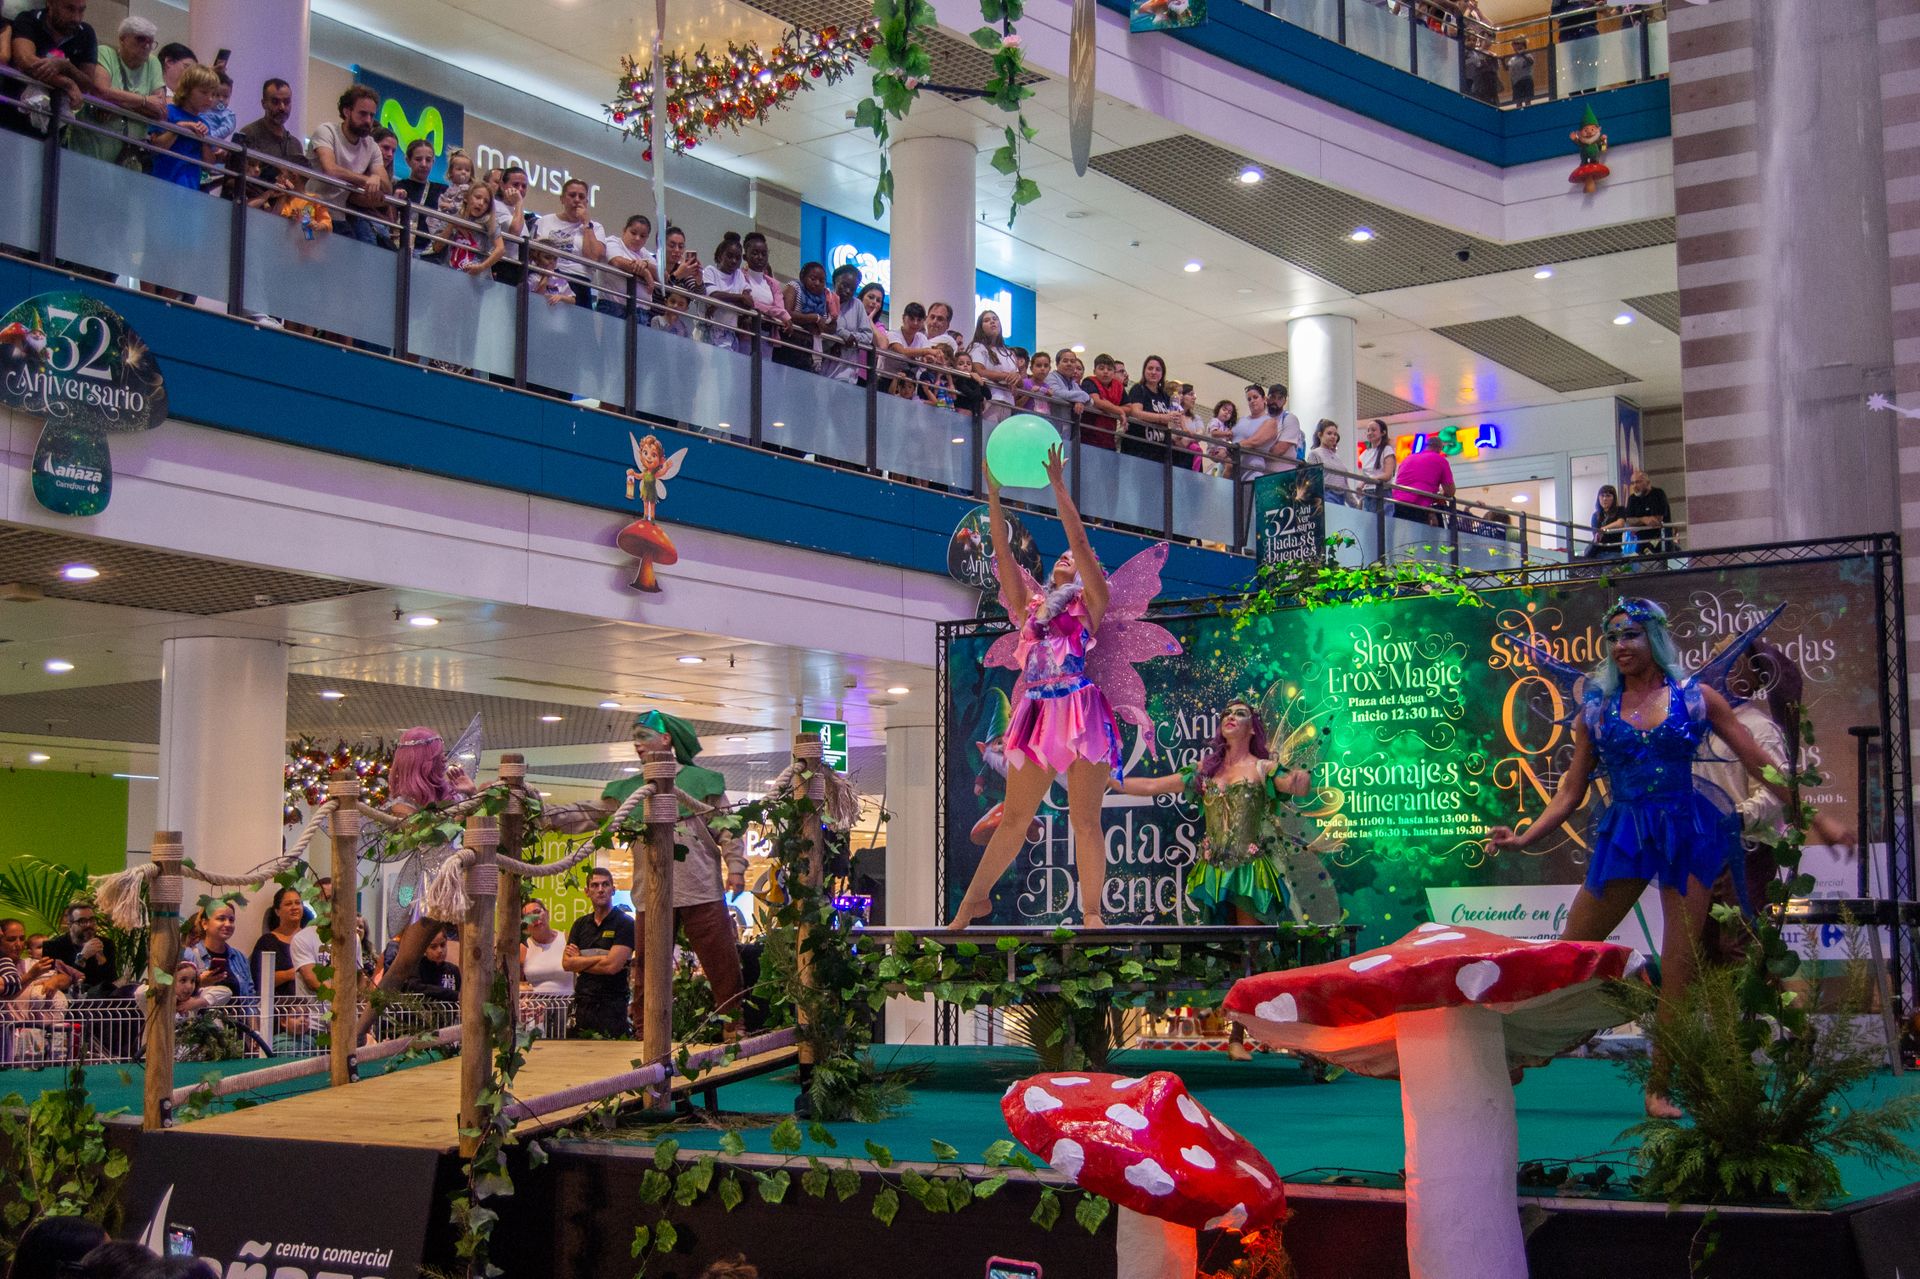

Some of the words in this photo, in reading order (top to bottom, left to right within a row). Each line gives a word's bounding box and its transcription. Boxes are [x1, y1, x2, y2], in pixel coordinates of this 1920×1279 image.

[477, 144, 601, 208] mvisr
[47, 305, 112, 381] 32
[6, 364, 144, 422] Aniversario
[1395, 424, 1501, 464] FISTA
[1264, 506, 1296, 538] 32
[1264, 532, 1306, 553] Hadas
[1350, 623, 1418, 665] Show
[1328, 667, 1382, 694] Erox
[1389, 660, 1462, 698] Magic
[1349, 696, 1377, 707] Plaza
[1379, 695, 1396, 705] del
[1399, 693, 1425, 706] Agua
[1352, 711, 1388, 723] Inicio
[1391, 708, 1428, 721] 12:30
[1430, 707, 1444, 719] h.
[1322, 758, 1459, 790] Personajes
[1345, 788, 1461, 814] Itinerantes
[1316, 818, 1343, 828] Desde
[1345, 817, 1358, 827] las
[1360, 816, 1384, 826] 11:00
[1398, 816, 1423, 826] hasta
[1425, 815, 1439, 825] las
[1441, 814, 1469, 824] 13:00
[1332, 829, 1358, 840] desde
[1359, 828, 1373, 839] las
[1375, 828, 1400, 838] 16:30
[1413, 827, 1438, 837] hasta
[1440, 826, 1453, 836] las
[1456, 824, 1483, 836] 19:30
[1027, 809, 1201, 868] Hdas
[1451, 903, 1528, 924] Creciendo
[1532, 909, 1552, 921] en
[275, 1242, 320, 1261] centro
[322, 1247, 394, 1268] comercial
